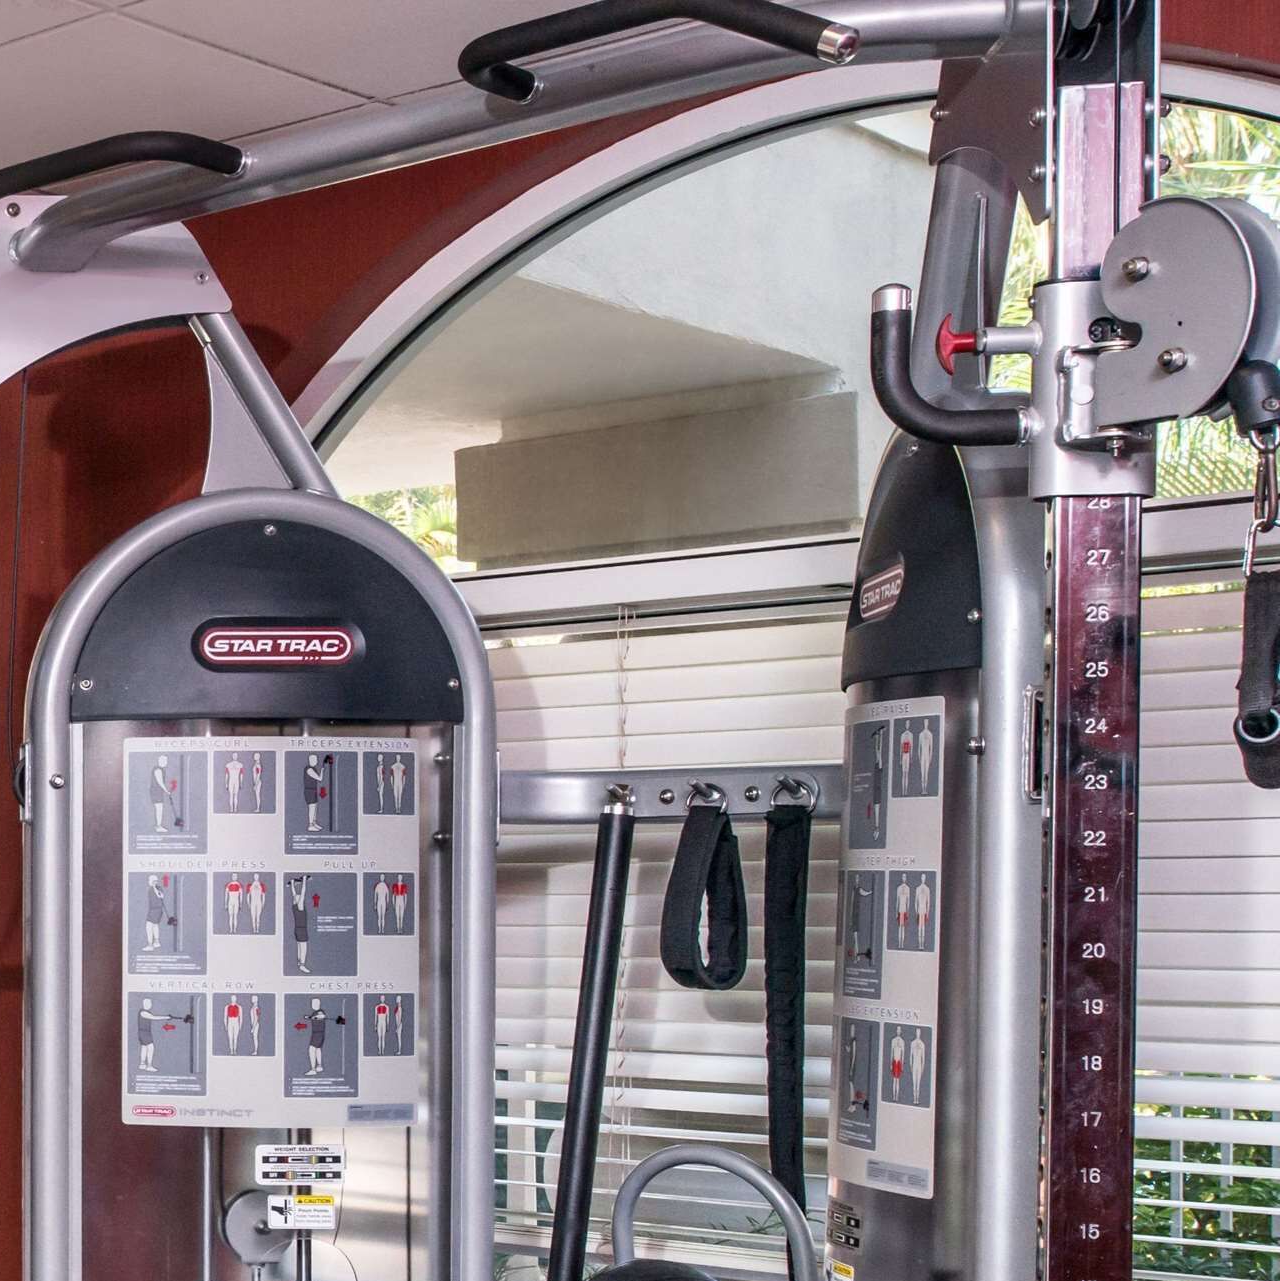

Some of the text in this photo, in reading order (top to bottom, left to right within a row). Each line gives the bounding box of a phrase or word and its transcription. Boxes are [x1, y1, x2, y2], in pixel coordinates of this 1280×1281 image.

[1087, 550, 1112, 565] 27
[861, 579, 901, 608] STAR TRAC
[1085, 606, 1110, 622] 26
[214, 639, 340, 653] STAR TRAC
[1085, 662, 1109, 678] 25
[1085, 718, 1108, 733] 24
[214, 740, 250, 748] CURL
[291, 739, 410, 749] TRICEPS EXTENSION
[1084, 775, 1107, 790] 23
[1083, 831, 1106, 846] 22
[139, 860, 267, 869] SHOULDER PRESS
[324, 861, 378, 869] PULL UP
[1084, 887, 1106, 902] 21
[1082, 943, 1105, 958] 20
[149, 981, 255, 990] VERTICAL ROW
[309, 982, 396, 990] CHEST PRESS
[1082, 999, 1103, 1015] 19
[1081, 1055, 1102, 1071] 18
[180, 1107, 256, 1117] INSTINCT
[1081, 1111, 1102, 1127] 17
[1080, 1167, 1101, 1184] 16
[1079, 1224, 1100, 1240] 15
